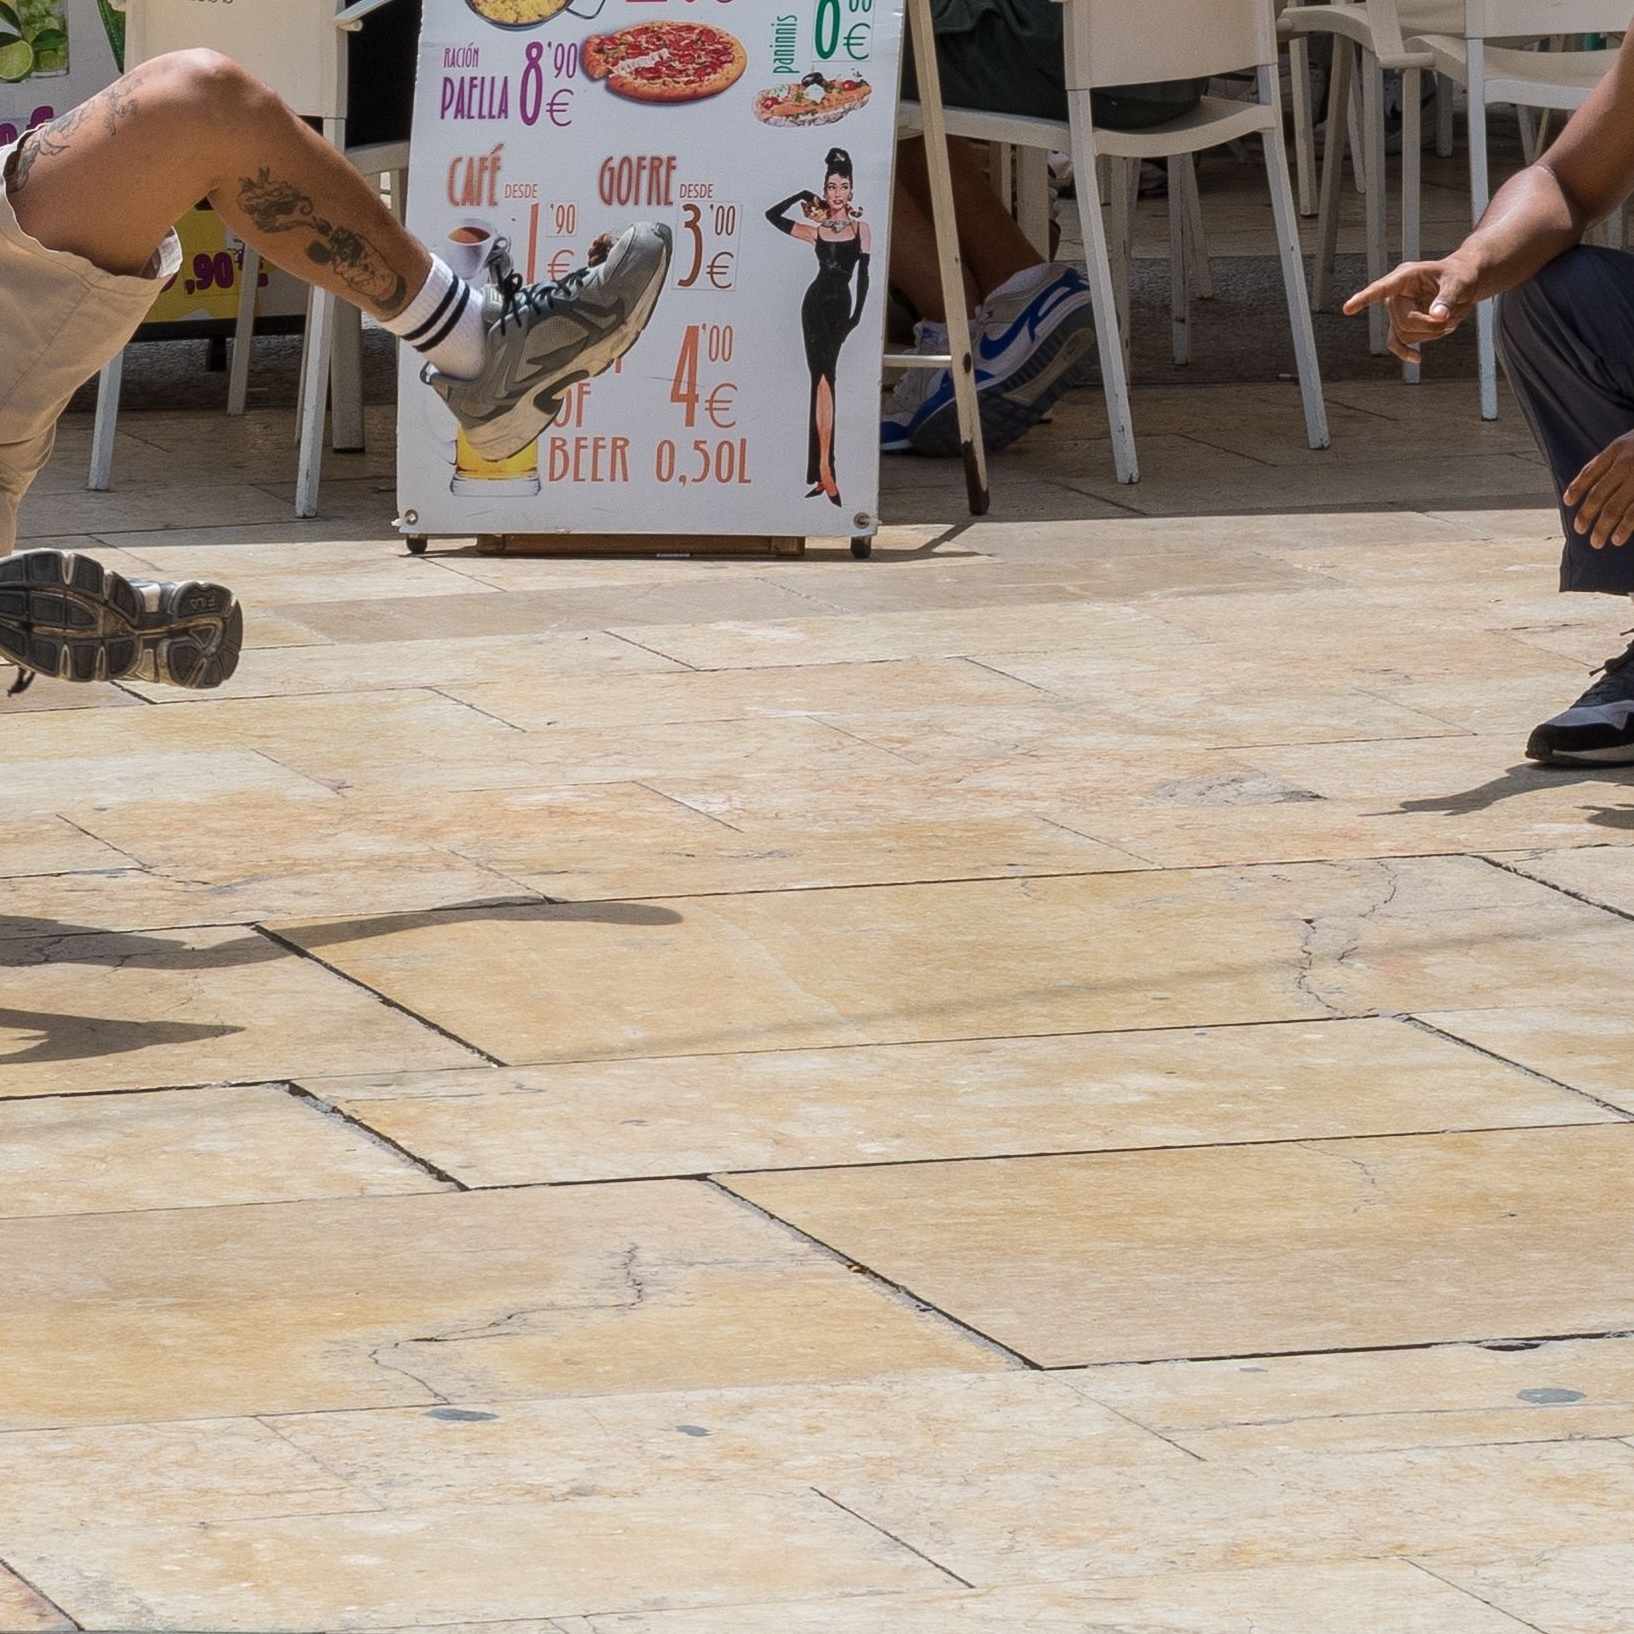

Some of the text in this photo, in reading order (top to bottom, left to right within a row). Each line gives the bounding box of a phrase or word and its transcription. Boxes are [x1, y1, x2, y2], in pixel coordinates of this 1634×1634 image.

[443, 41, 479, 67] RACIÓN
[440, 76, 509, 120] PAELLA
[447, 142, 538, 207] CAFÉ DESDE
[599, 155, 714, 207] GOFRE DESDE
[548, 436, 751, 486] BEER 0,50L
